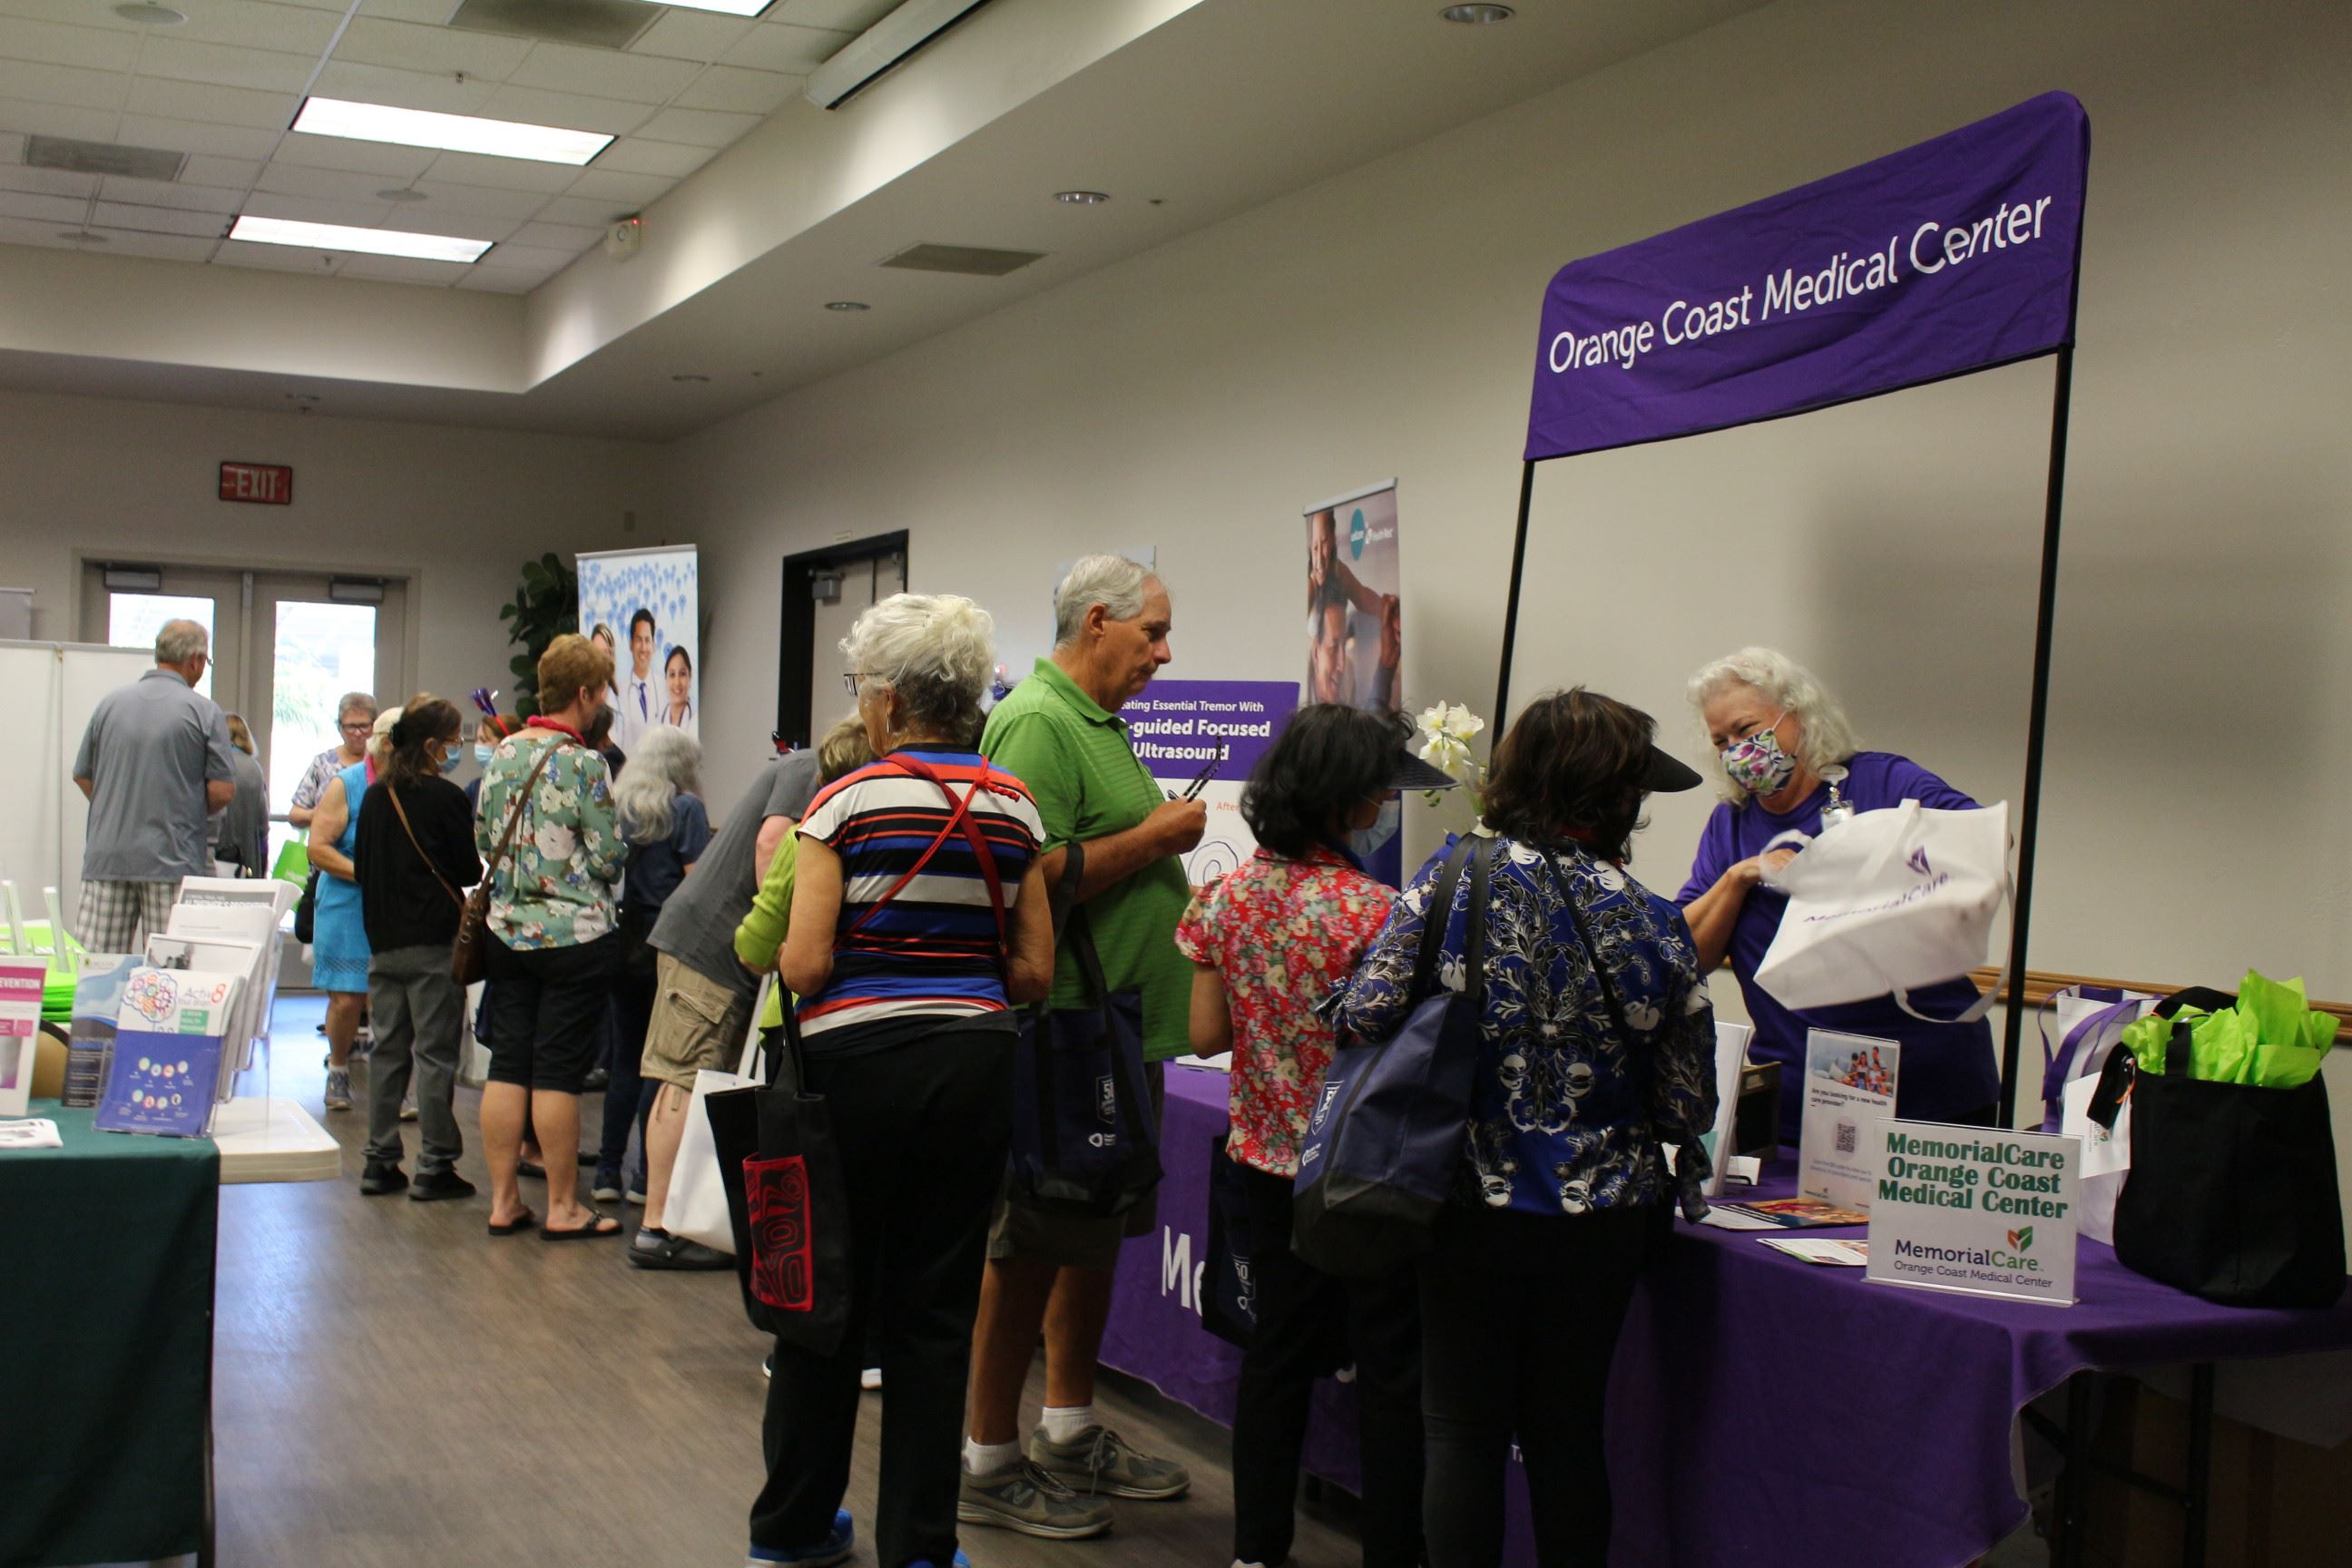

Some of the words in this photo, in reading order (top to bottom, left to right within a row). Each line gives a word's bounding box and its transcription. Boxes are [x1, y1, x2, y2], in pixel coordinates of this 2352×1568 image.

[1548, 319, 1655, 373] Orange
[1661, 286, 1753, 345] Coast
[1761, 234, 1899, 321] Medical
[1908, 195, 2052, 275] Center
[236, 468, 279, 500] EXIT
[1152, 700, 1197, 711] Essential
[1199, 701, 1237, 712] Tremor
[1239, 701, 1264, 712] With
[1197, 719, 1271, 738] Focused
[1132, 741, 1230, 760] Ultrasound
[1886, 1132, 2064, 1170] MemorialCare
[1887, 1156, 1979, 1189] Orange
[1987, 1166, 2061, 1194] Coast
[1878, 1179, 1974, 1209] Medical
[1982, 1190, 2068, 1219] Center
[1895, 1240, 2038, 1271] MemorialCare
[1894, 1260, 1934, 1275] Orange
[1936, 1265, 1967, 1278] Coast
[1969, 1269, 2012, 1284] Medical
[2015, 1275, 2053, 1288] Center
